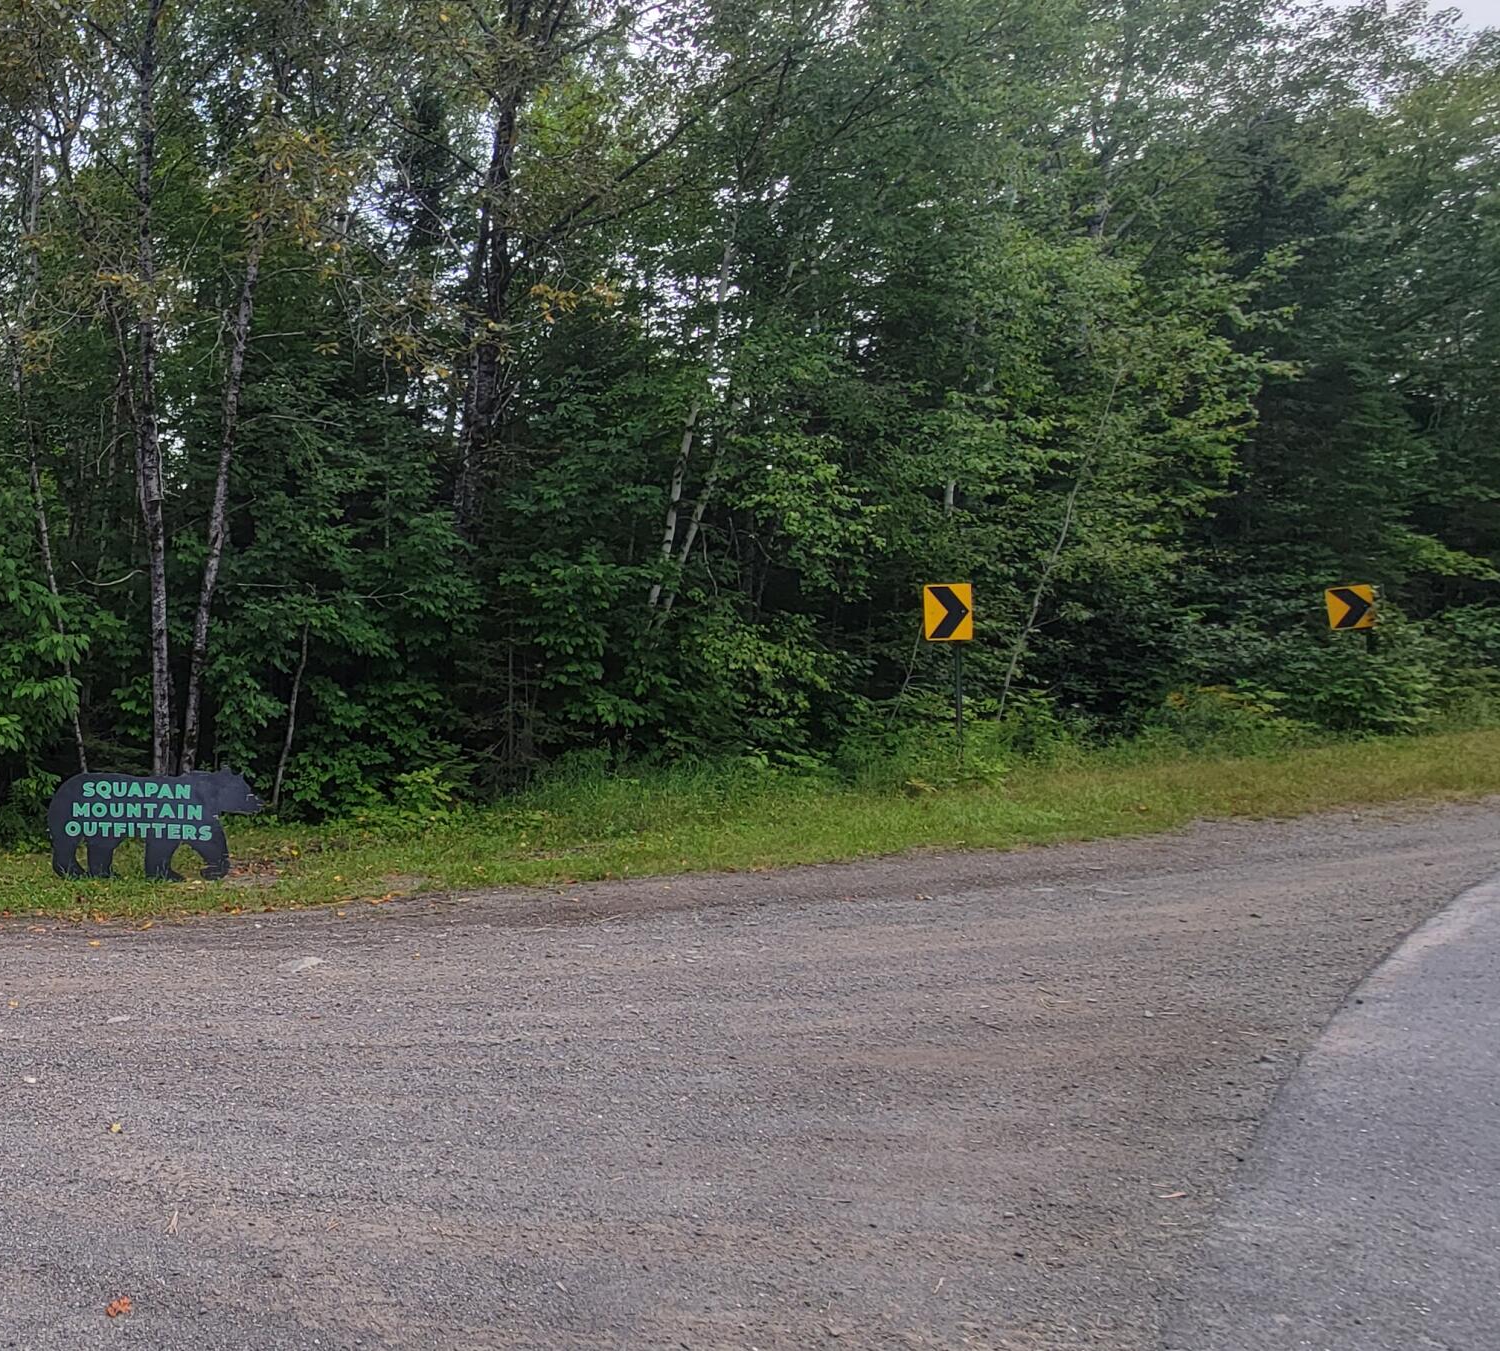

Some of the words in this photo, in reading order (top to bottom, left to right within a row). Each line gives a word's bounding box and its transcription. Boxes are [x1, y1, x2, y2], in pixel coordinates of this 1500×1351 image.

[83, 780, 191, 799] SQUAPAN
[72, 802, 203, 820] MOUNTAIN
[65, 821, 212, 841] OUTFITTERS
